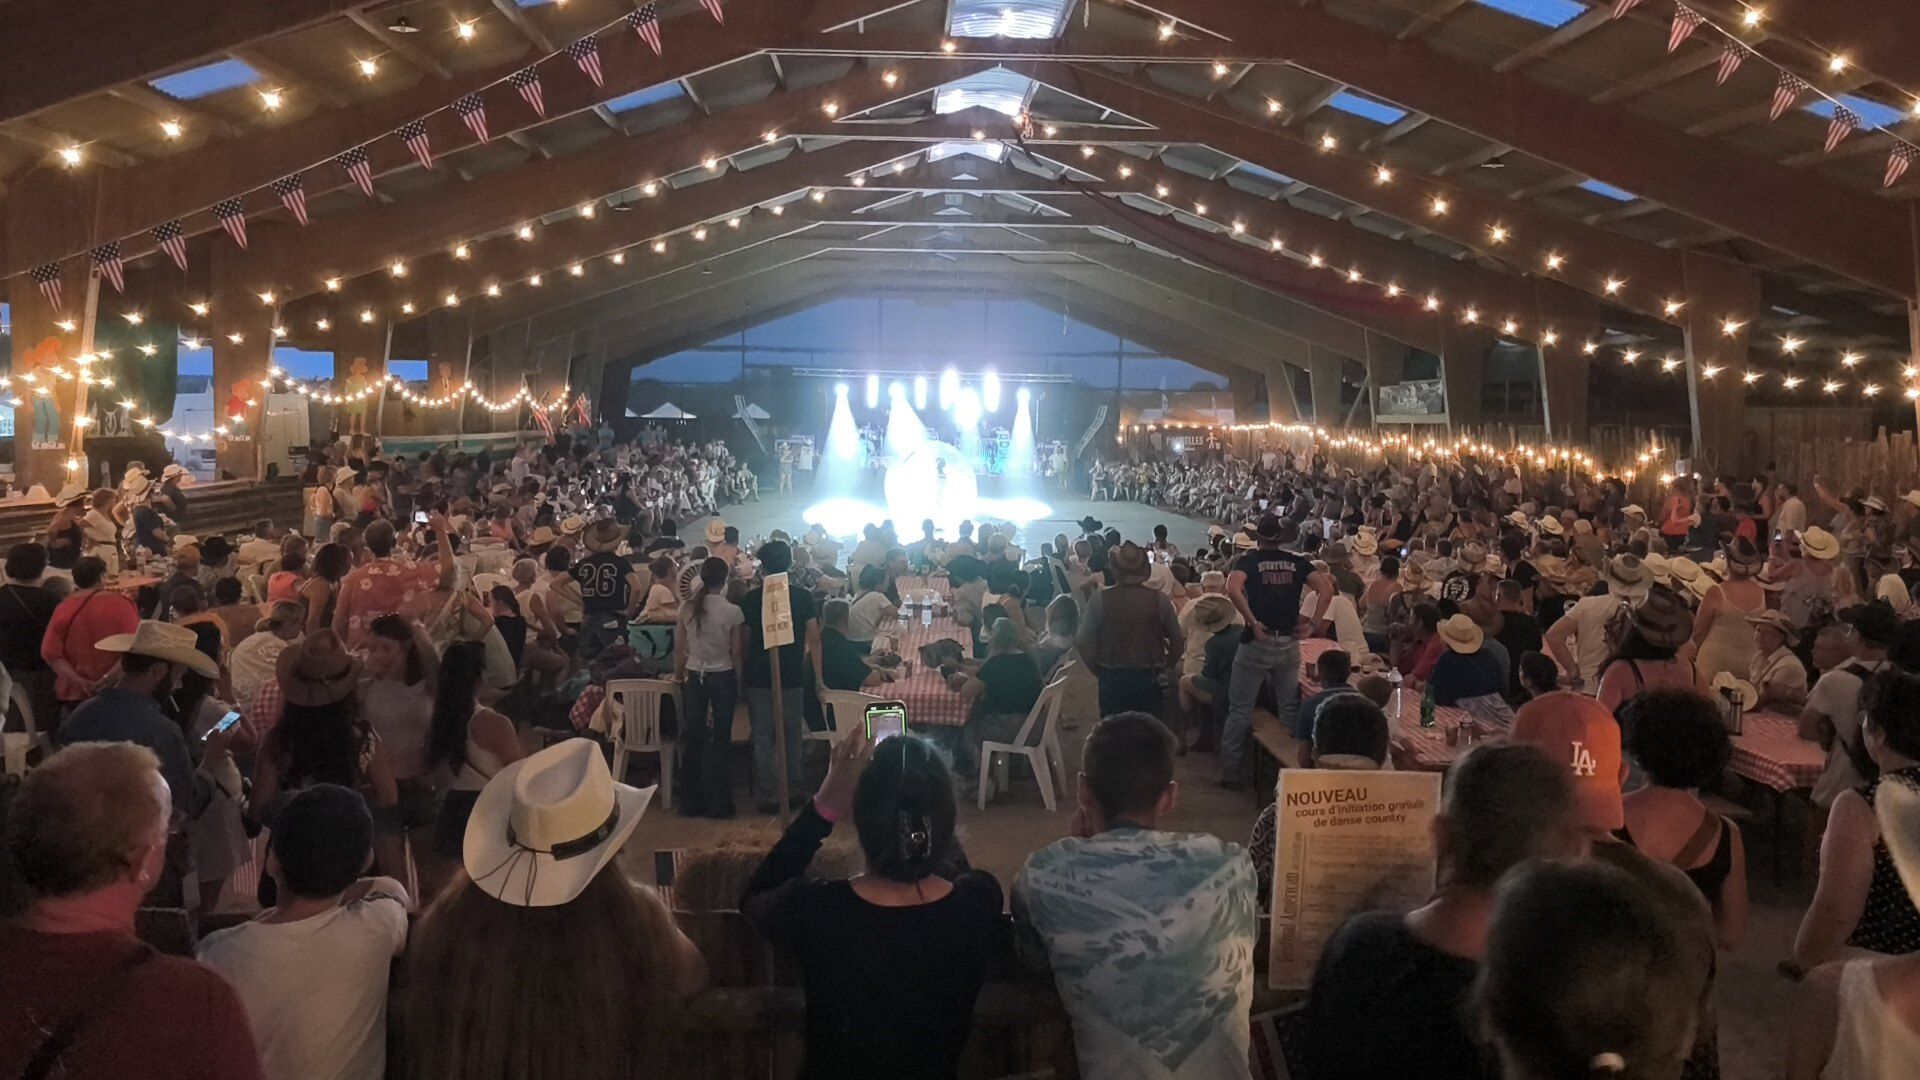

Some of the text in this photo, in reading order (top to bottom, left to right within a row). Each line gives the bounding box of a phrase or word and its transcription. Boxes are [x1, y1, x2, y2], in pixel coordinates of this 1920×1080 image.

[579, 563, 618, 597] 26
[1569, 741, 1597, 777] LA
[1286, 787, 1368, 808] NOUVEAU
[1295, 807, 1326, 818] cours
[1328, 801, 1385, 815] d'initiation
[1314, 813, 1407, 828] de danse country
